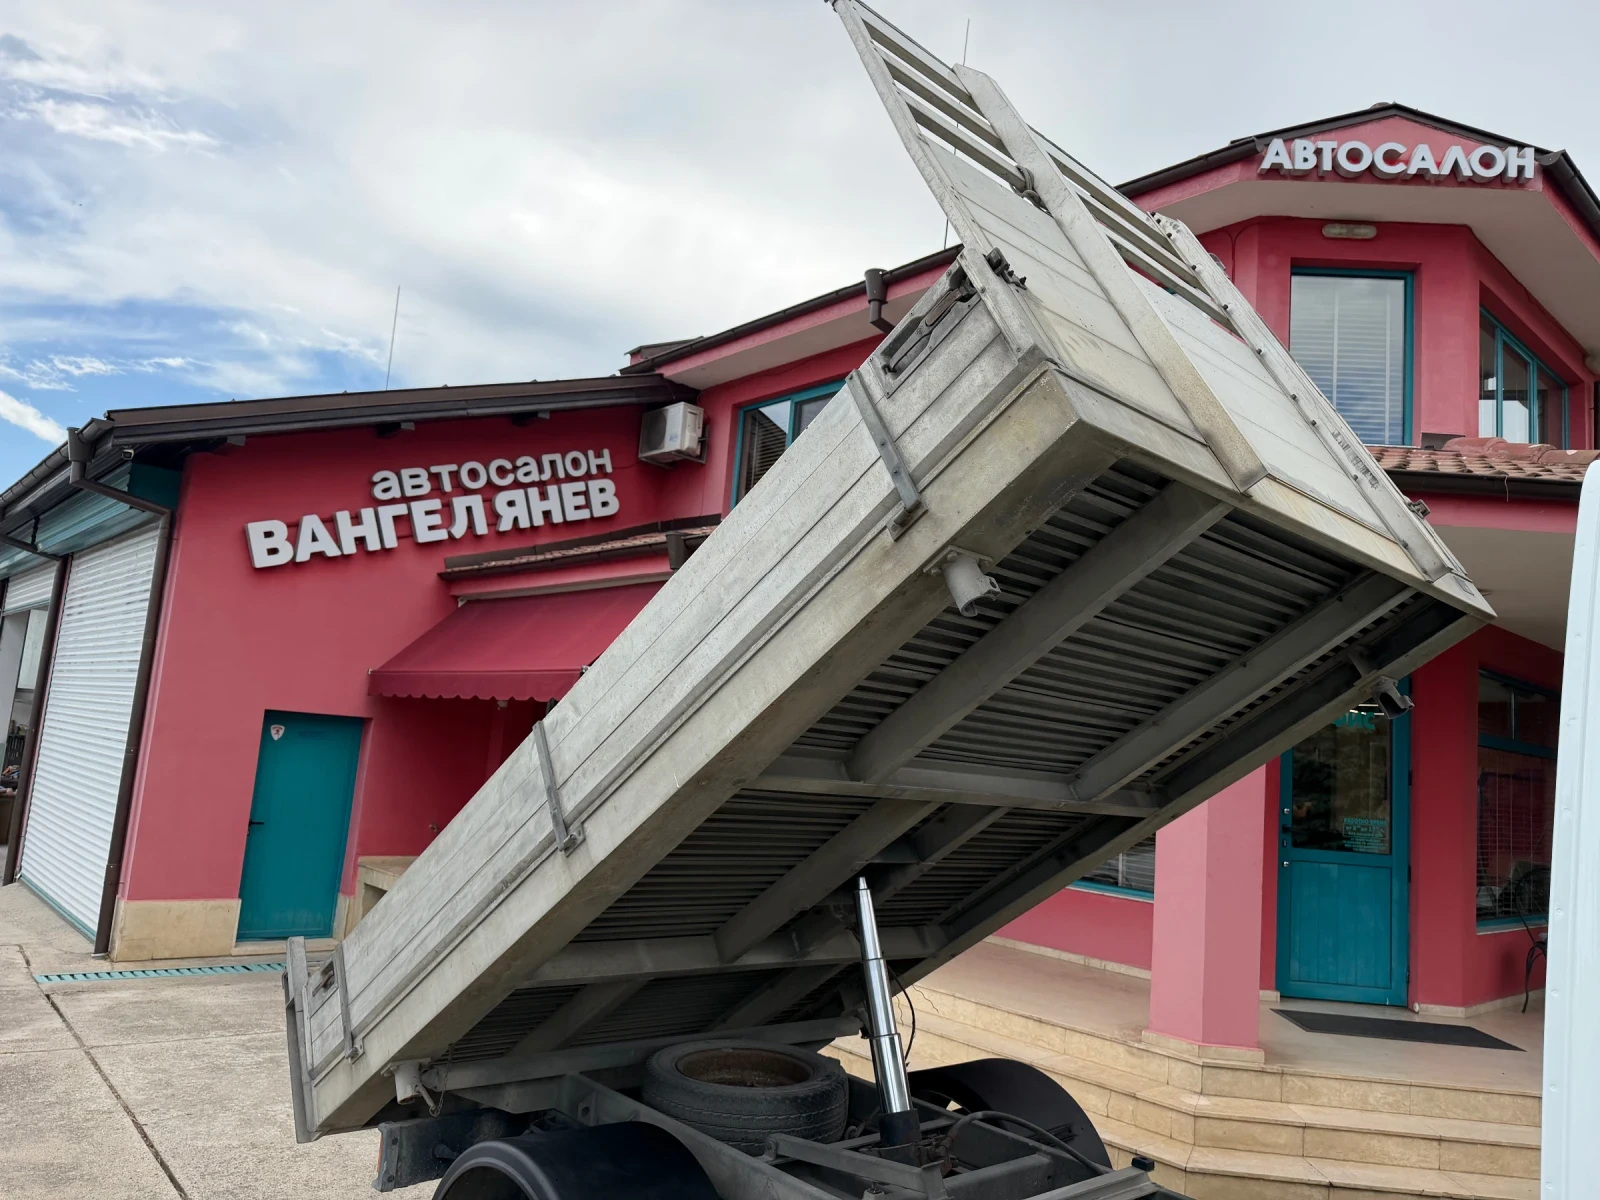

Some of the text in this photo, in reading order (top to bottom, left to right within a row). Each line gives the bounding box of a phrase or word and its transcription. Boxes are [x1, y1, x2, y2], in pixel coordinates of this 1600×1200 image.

[1258, 138, 1535, 182] АВТОСАЛОН
[372, 448, 613, 500] автосалон
[245, 478, 620, 568] ВАНГЕЛ ЯНЕВ
